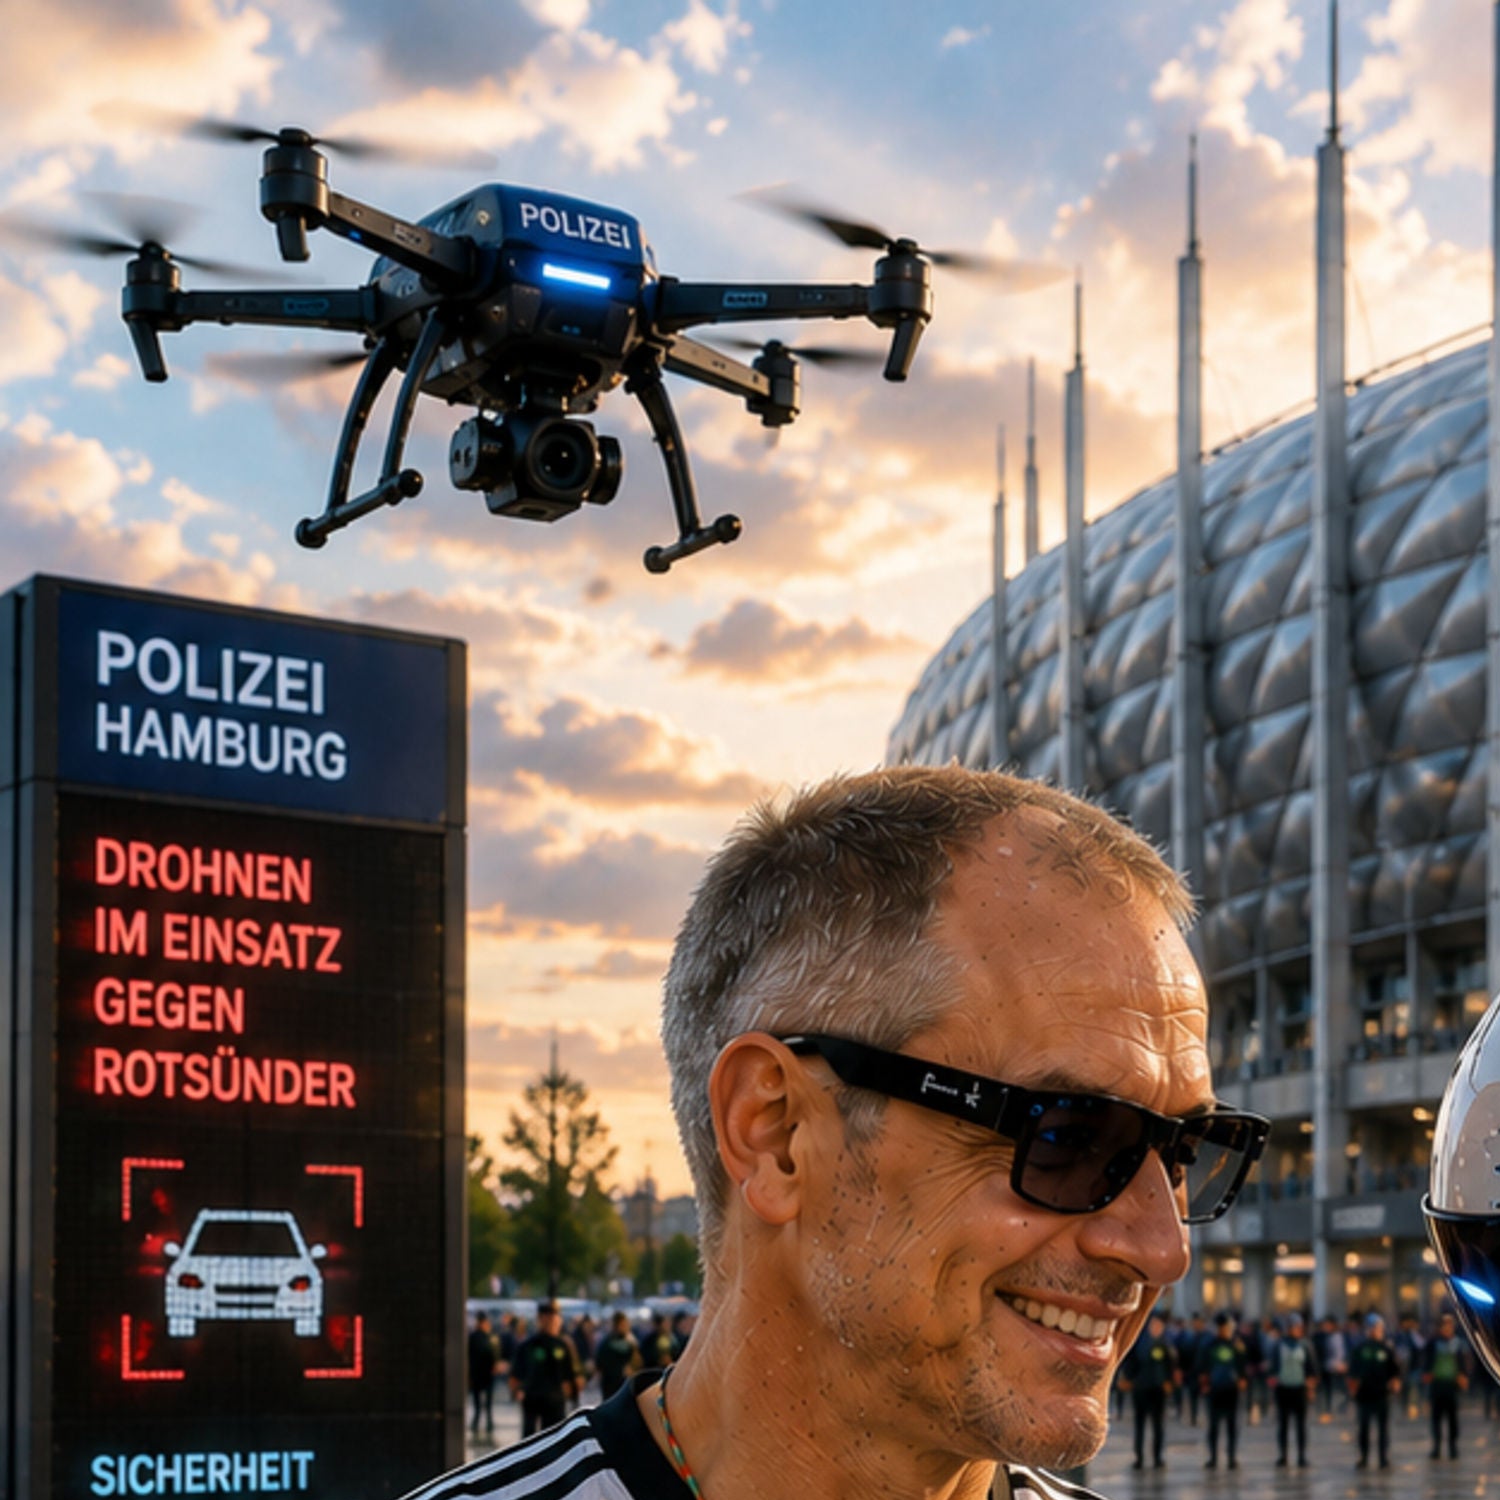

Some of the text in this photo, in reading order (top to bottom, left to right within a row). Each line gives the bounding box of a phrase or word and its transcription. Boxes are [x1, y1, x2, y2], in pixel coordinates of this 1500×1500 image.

[520, 203, 631, 249] POLIZEI
[97, 630, 324, 714] POLIZEI
[97, 703, 346, 780] HAMBURG
[96, 838, 310, 903] DROHNEN
[96, 907, 340, 972] IM EINSATZ
[94, 978, 243, 1033] GEGEN
[95, 1046, 355, 1107] ROTSÜNDER
[92, 1452, 313, 1495] SICHERHEIT
